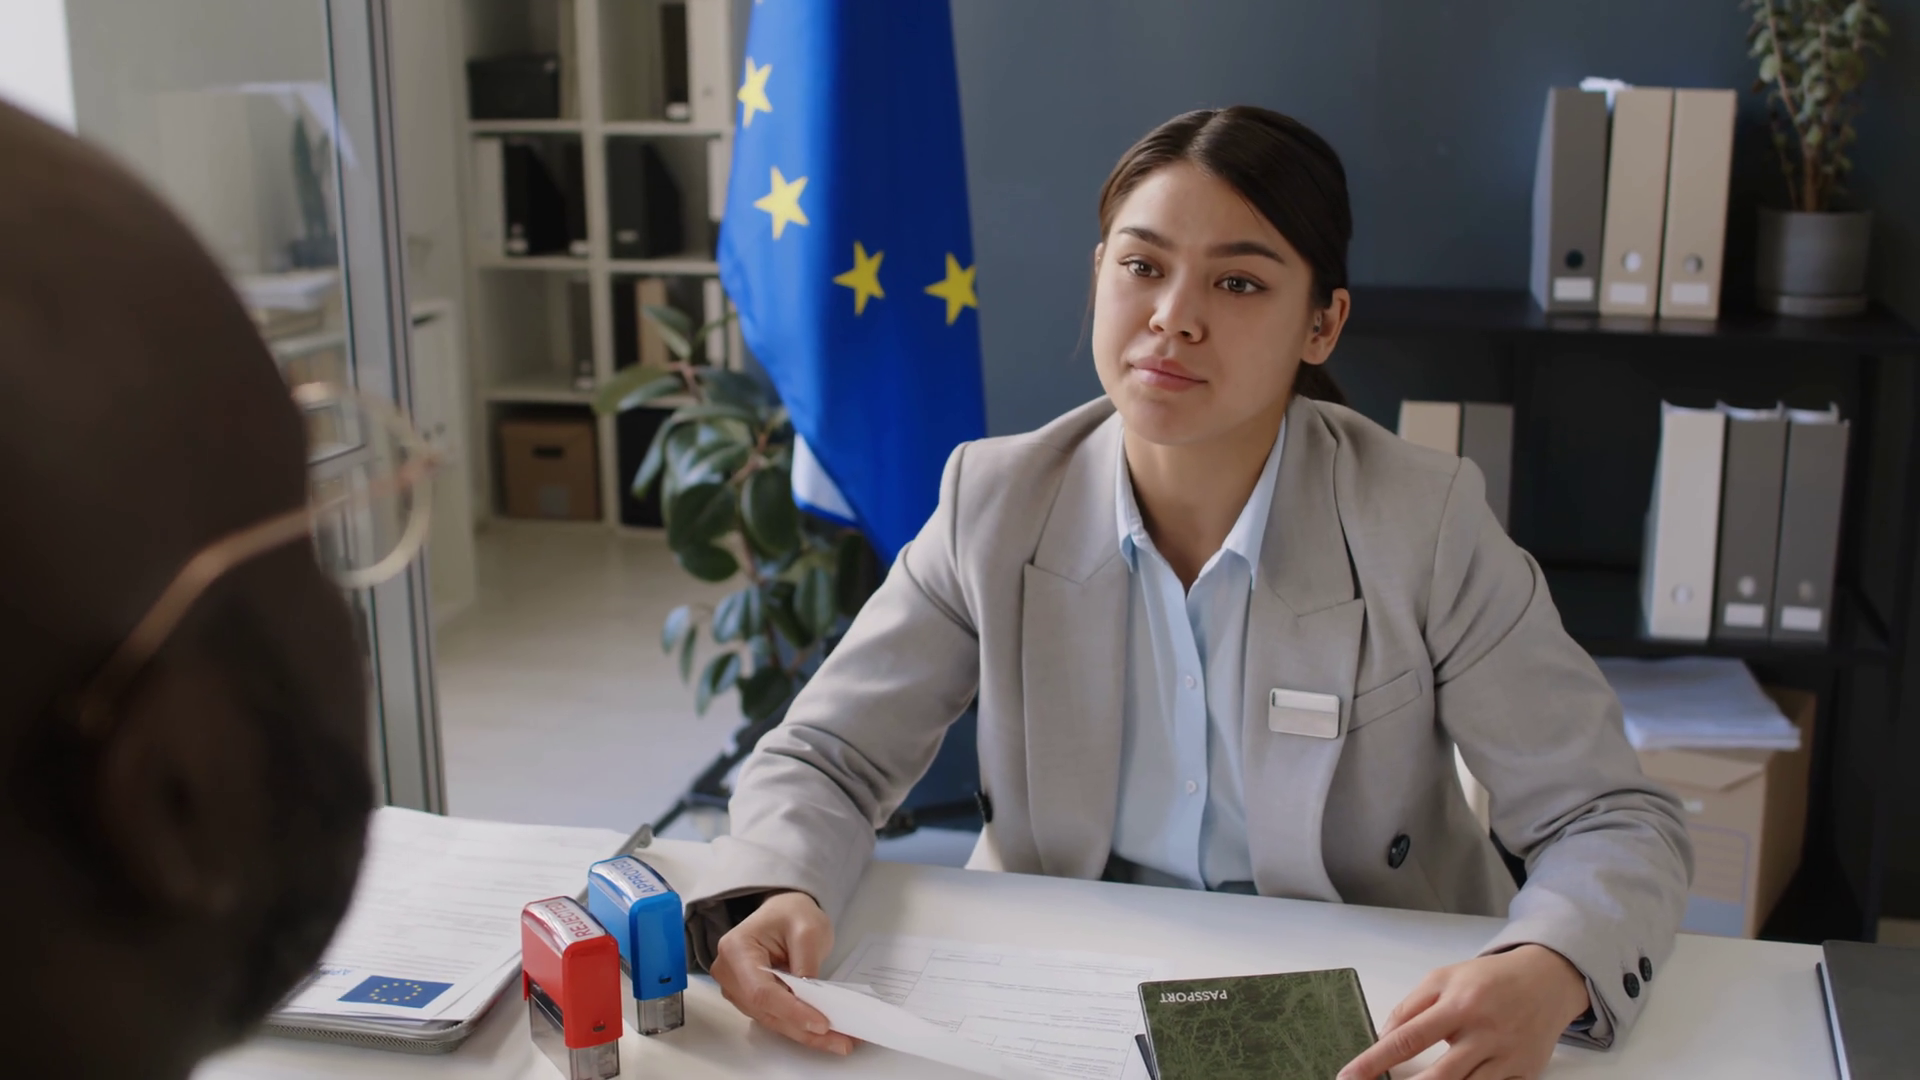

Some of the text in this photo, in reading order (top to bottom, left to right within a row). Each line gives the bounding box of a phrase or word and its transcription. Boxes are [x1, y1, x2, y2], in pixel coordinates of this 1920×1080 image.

[611, 860, 659, 893] APPROVED
[545, 902, 594, 938] REJECTED
[1160, 989, 1228, 1003] PASSPORT
